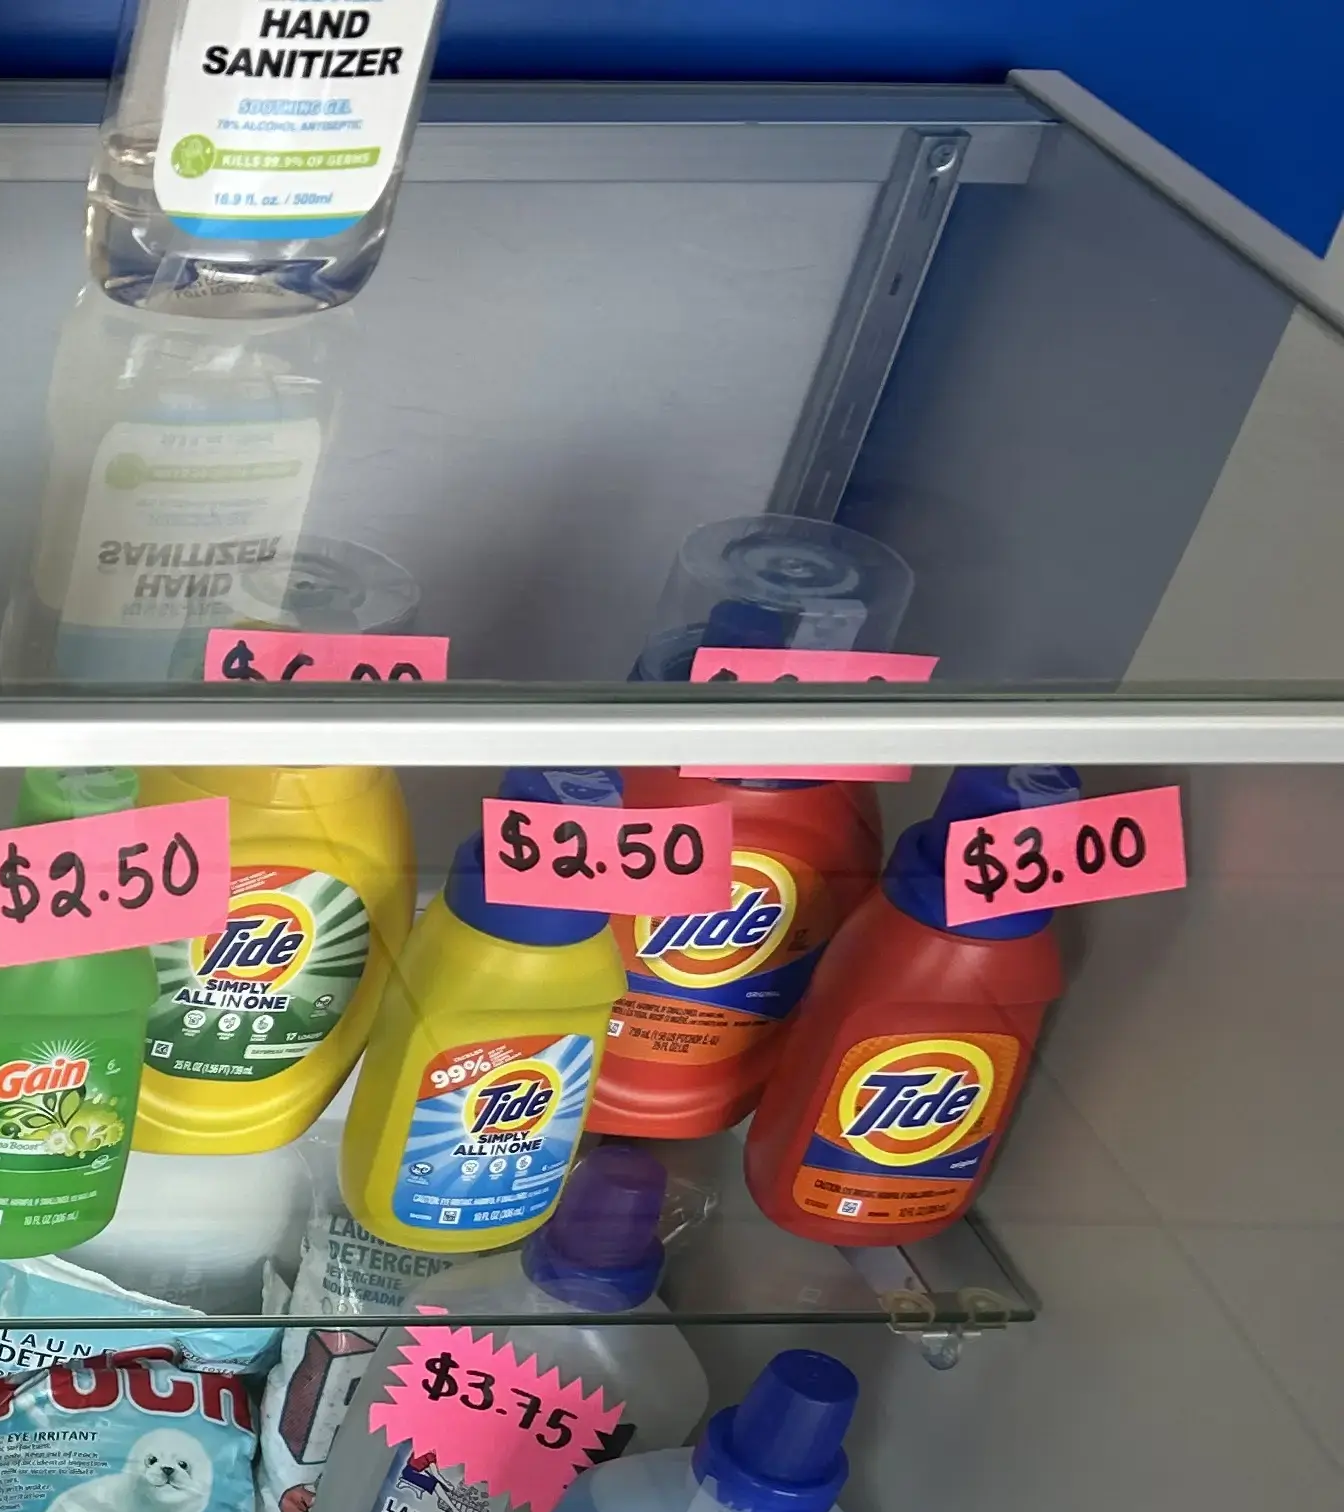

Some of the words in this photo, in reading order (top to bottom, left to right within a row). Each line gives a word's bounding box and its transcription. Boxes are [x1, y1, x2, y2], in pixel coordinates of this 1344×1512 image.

[260, 9, 369, 39] HAND
[203, 45, 402, 77] SANITIZER
[498, 811, 704, 880] $2.50
[963, 817, 1146, 902] $3.00
[197, 919, 305, 976] Tide
[173, 989, 216, 1006] ALL
[220, 994, 243, 1008] IN
[244, 996, 287, 1010] ONE
[206, 979, 272, 995] SIMPLY
[471, 1080, 553, 1133] Tide
[845, 1072, 982, 1137] Tide
[454, 1140, 487, 1156] ALL
[490, 1143, 507, 1155] IN
[509, 1138, 542, 1153] ONE
[478, 1131, 530, 1144] SIMPLY
[421, 1351, 579, 1450] $3.75
[8, 1433, 30, 1442] EYE
[34, 1431, 97, 1441] IRRITANT
